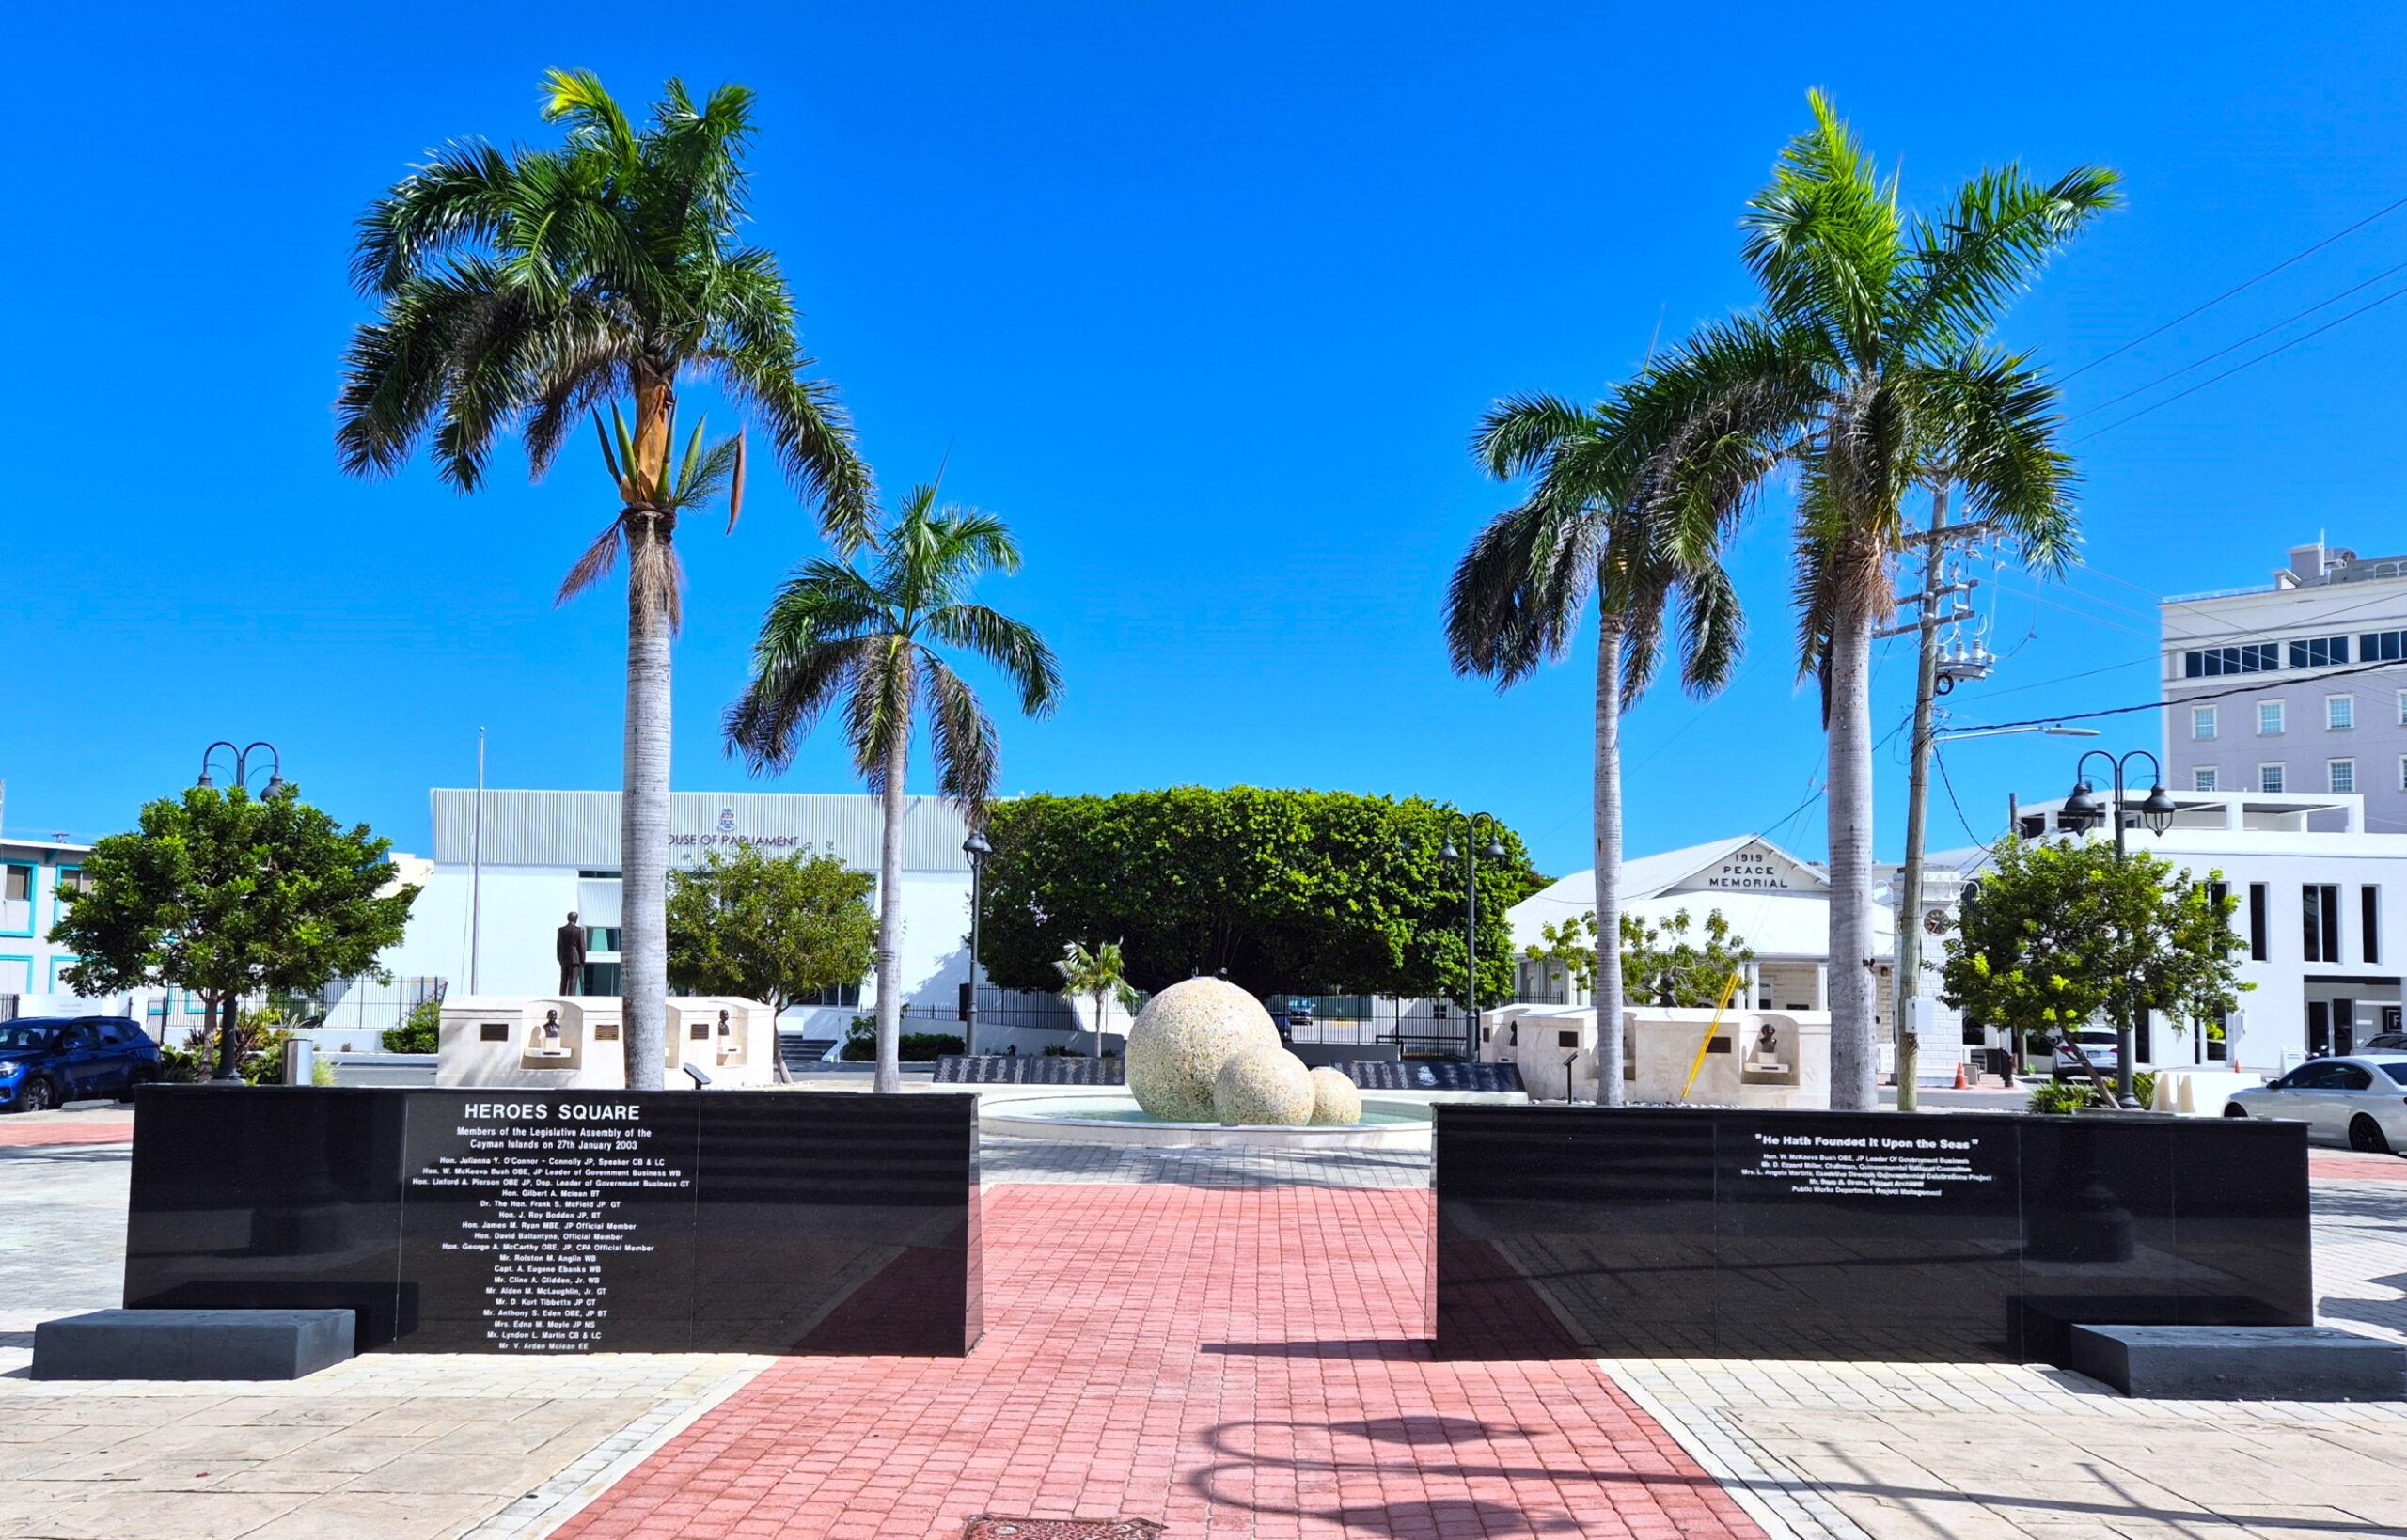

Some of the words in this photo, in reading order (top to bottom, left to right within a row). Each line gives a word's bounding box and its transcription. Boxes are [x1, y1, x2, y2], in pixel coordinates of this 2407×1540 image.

[668, 834, 697, 845] OUSE
[700, 834, 718, 846] OF
[1735, 854, 1763, 862] 1919
[1723, 866, 1774, 875] PEACE
[1709, 878, 1788, 888] MEMORIAL
[464, 1104, 547, 1119] HEROES
[558, 1105, 639, 1120] SQUARE
[457, 1127, 496, 1136] Members
[499, 1127, 509, 1136] of
[512, 1127, 527, 1136] the
[530, 1127, 576, 1139] Legislative
[580, 1128, 621, 1139] Assembly
[625, 1128, 634, 1137] of
[638, 1128, 652, 1138] the
[470, 1139, 504, 1151] Cayman
[508, 1139, 539, 1149] Islands
[558, 1140, 574, 1149] 27th
[578, 1140, 612, 1152] January
[616, 1140, 637, 1150] 2003
[1783, 1136, 1811, 1145] Hath
[1815, 1137, 1866, 1146] Founded
[1881, 1138, 1913, 1150] Upon
[1916, 1139, 1937, 1148] the
